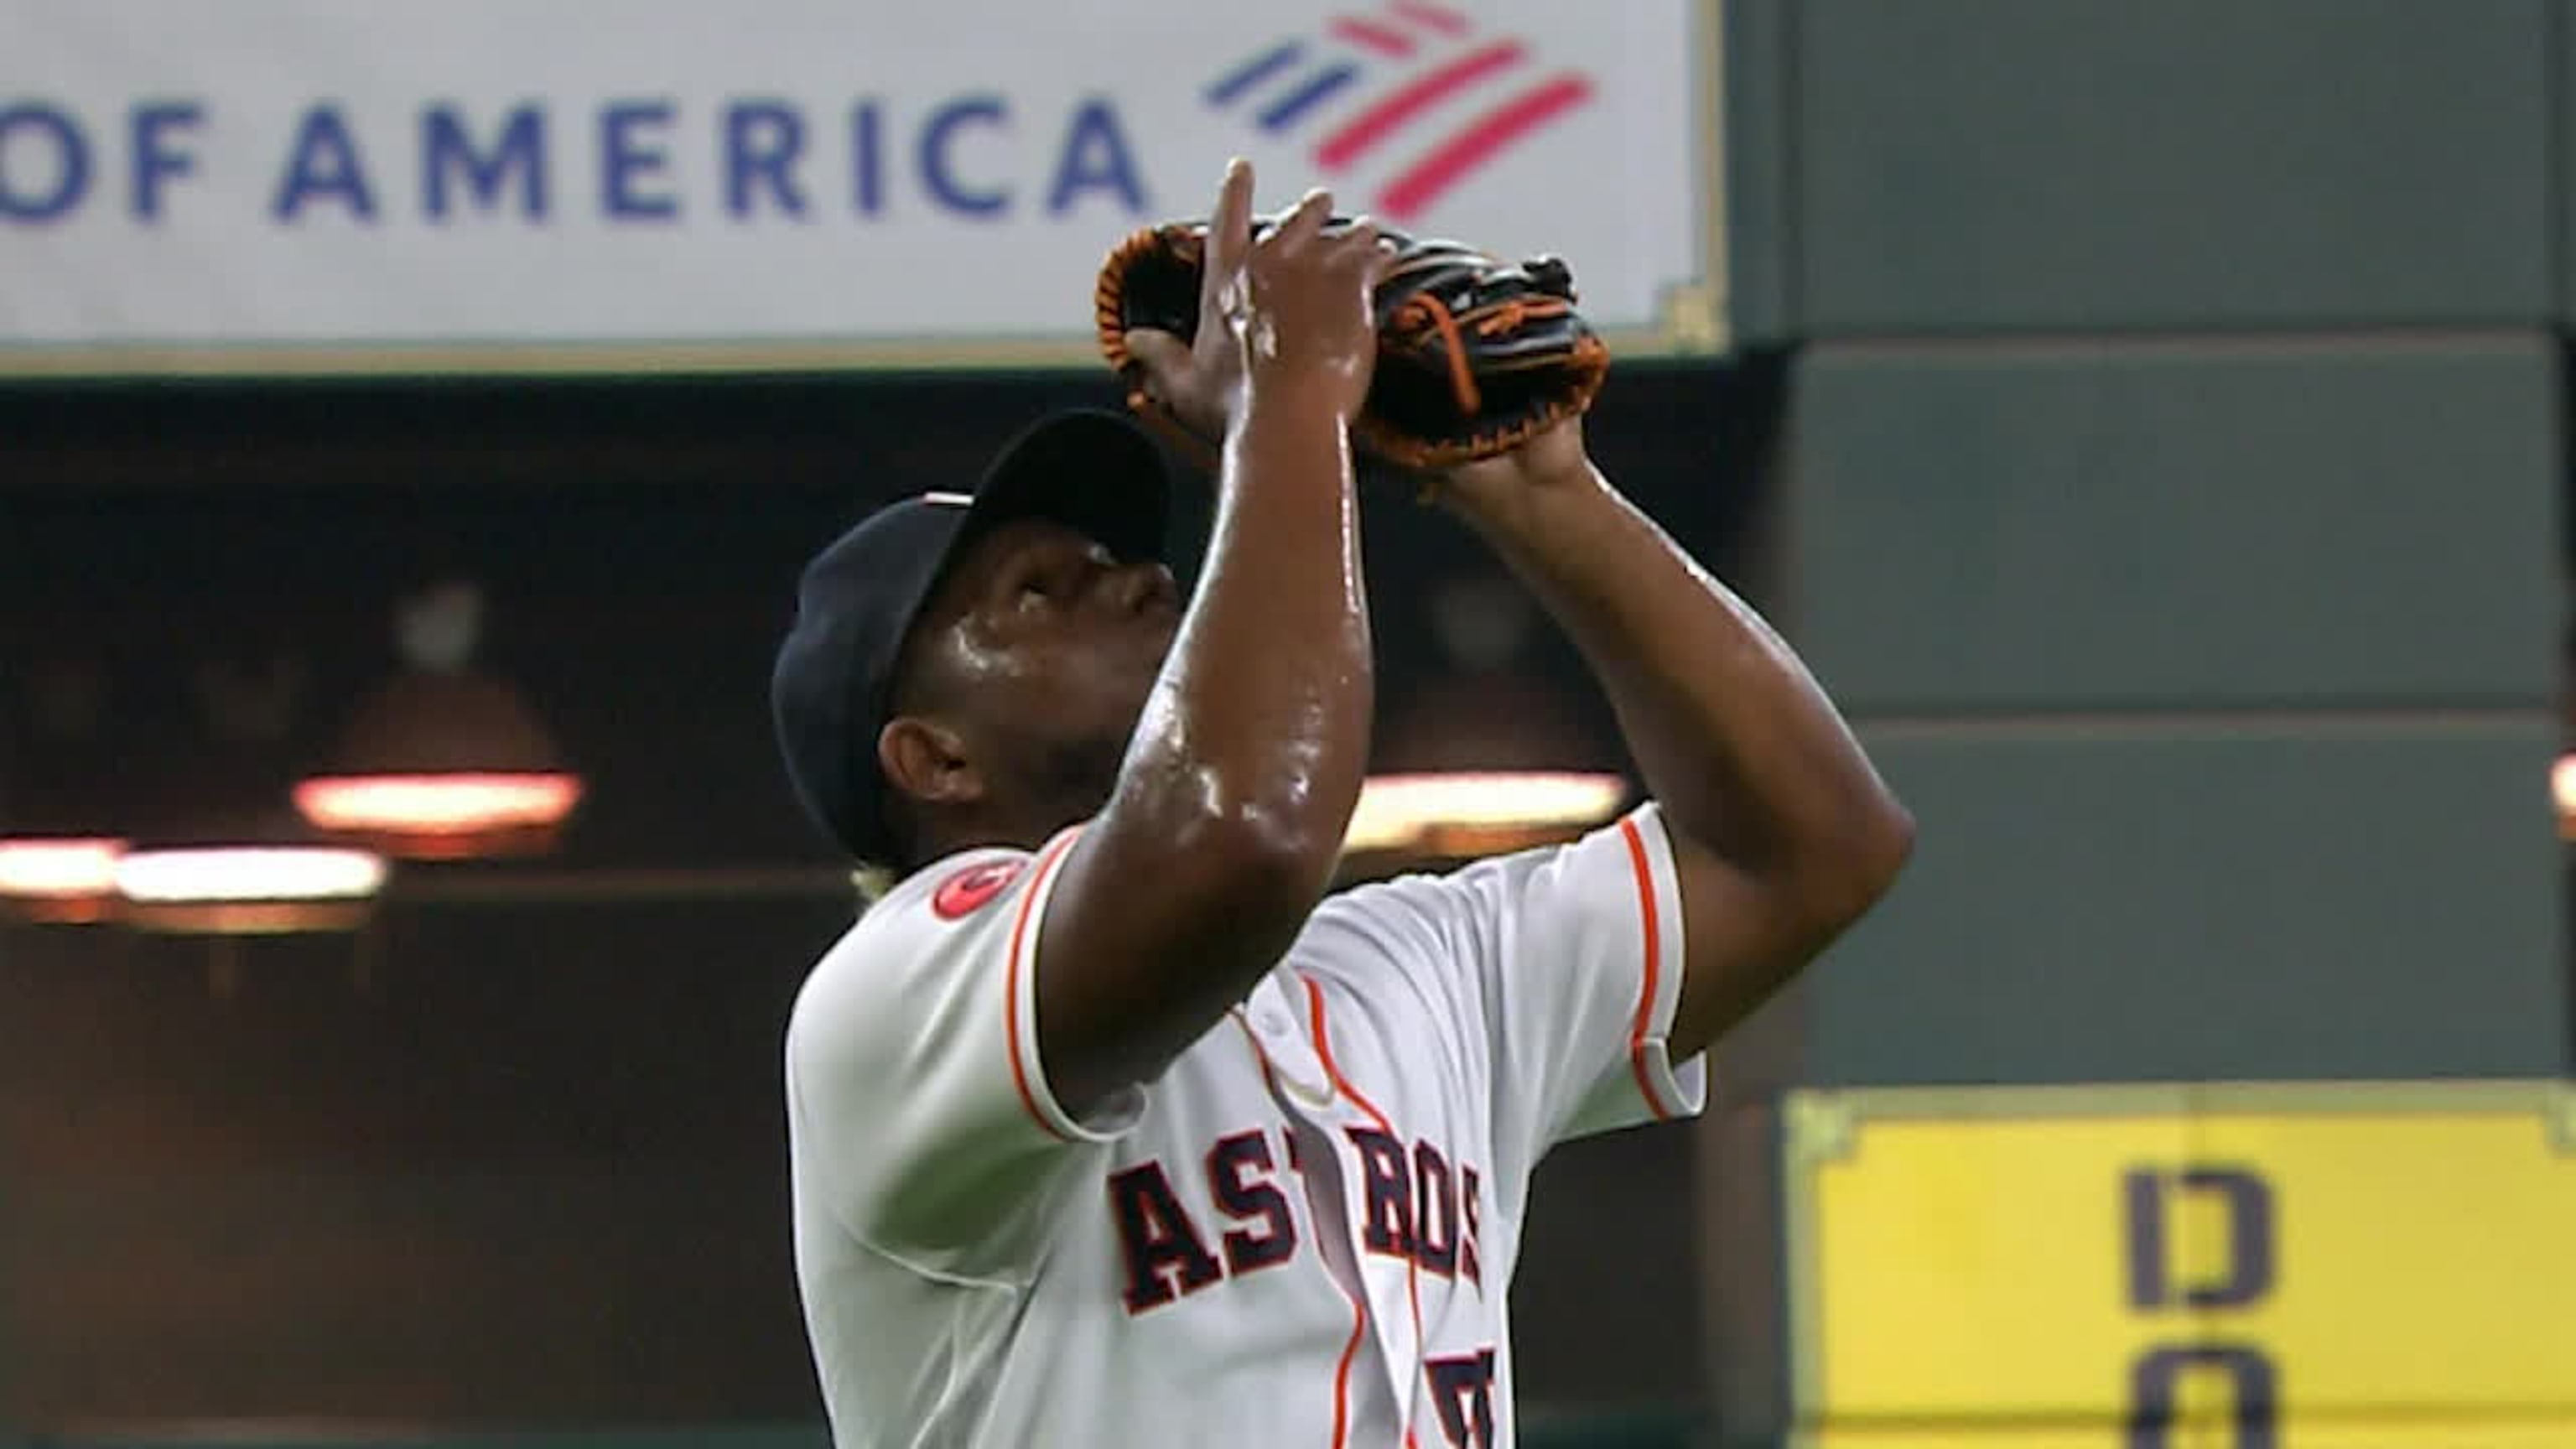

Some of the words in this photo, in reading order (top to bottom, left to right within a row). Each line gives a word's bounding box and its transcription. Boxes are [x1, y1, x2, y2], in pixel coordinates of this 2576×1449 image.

[0, 100, 206, 225] OF
[268, 94, 1147, 225] AMERICA
[1107, 1124, 1484, 1317] ASROS
